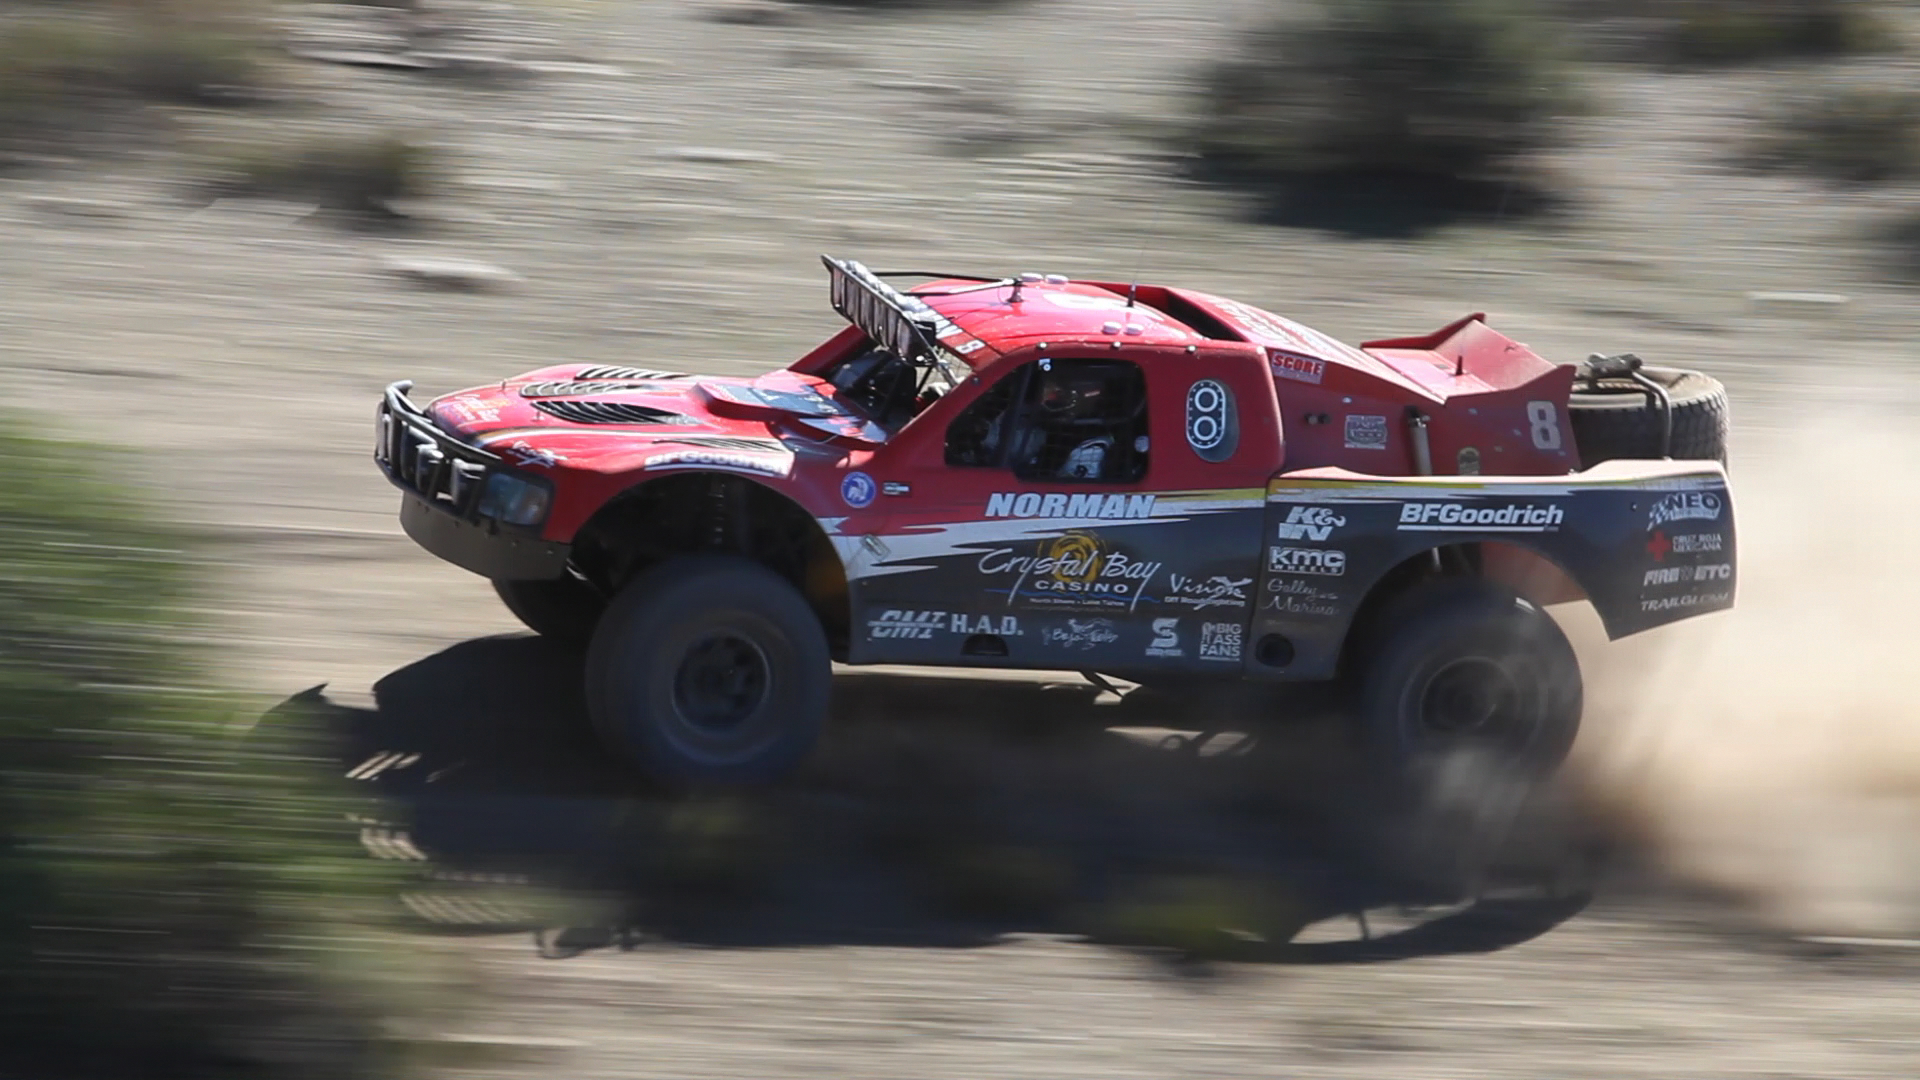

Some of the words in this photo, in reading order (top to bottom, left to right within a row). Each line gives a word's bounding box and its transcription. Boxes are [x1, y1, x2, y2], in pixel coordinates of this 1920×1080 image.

[1273, 354, 1323, 375] SCORE
[1527, 401, 1561, 450] 8
[985, 493, 1155, 519] NORMAN
[1665, 492, 1722, 511] NEO
[1399, 503, 1564, 525] BFGoodrich
[978, 548, 1098, 607] Crystal
[1101, 552, 1162, 612] Bay
[1035, 580, 1129, 594] CASINO
[951, 613, 1024, 636] H.A.D.
[1216, 623, 1242, 634] BIG
[1199, 643, 1241, 657] FANS
[1213, 634, 1242, 646] ASS
